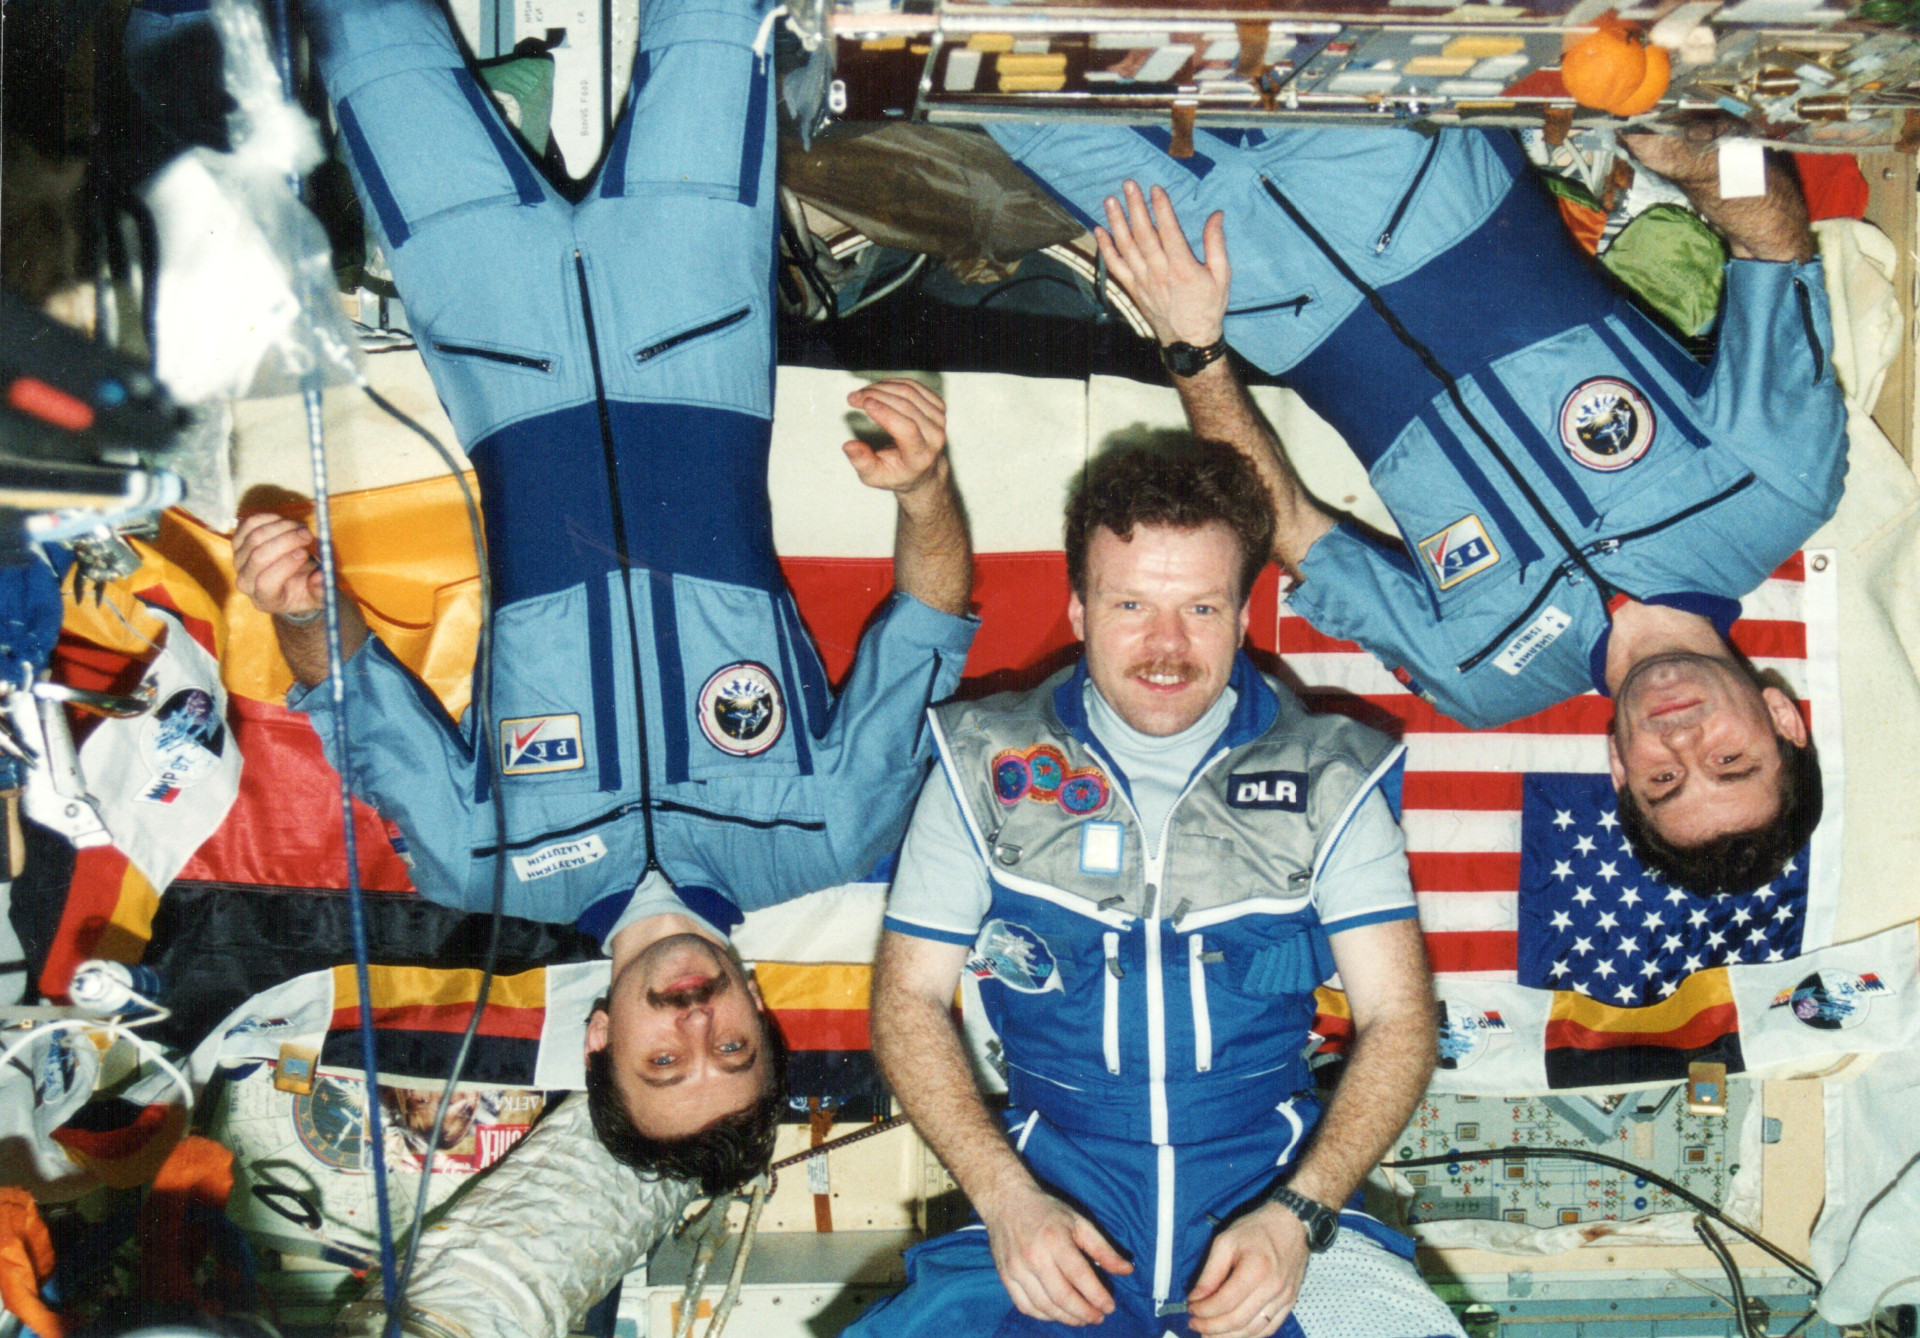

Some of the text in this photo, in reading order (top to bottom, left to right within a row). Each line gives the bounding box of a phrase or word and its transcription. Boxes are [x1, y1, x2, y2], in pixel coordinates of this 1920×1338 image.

[580, 80, 590, 136] BONUS FOOD
[1236, 779, 1297, 804] DLR
[526, 844, 581, 867] LAZUTKIN
[526, 856, 587, 879] ЛАЗУТКИН
[1855, 979, 1885, 992] МИР
[1477, 1016, 1506, 1029] МИР
